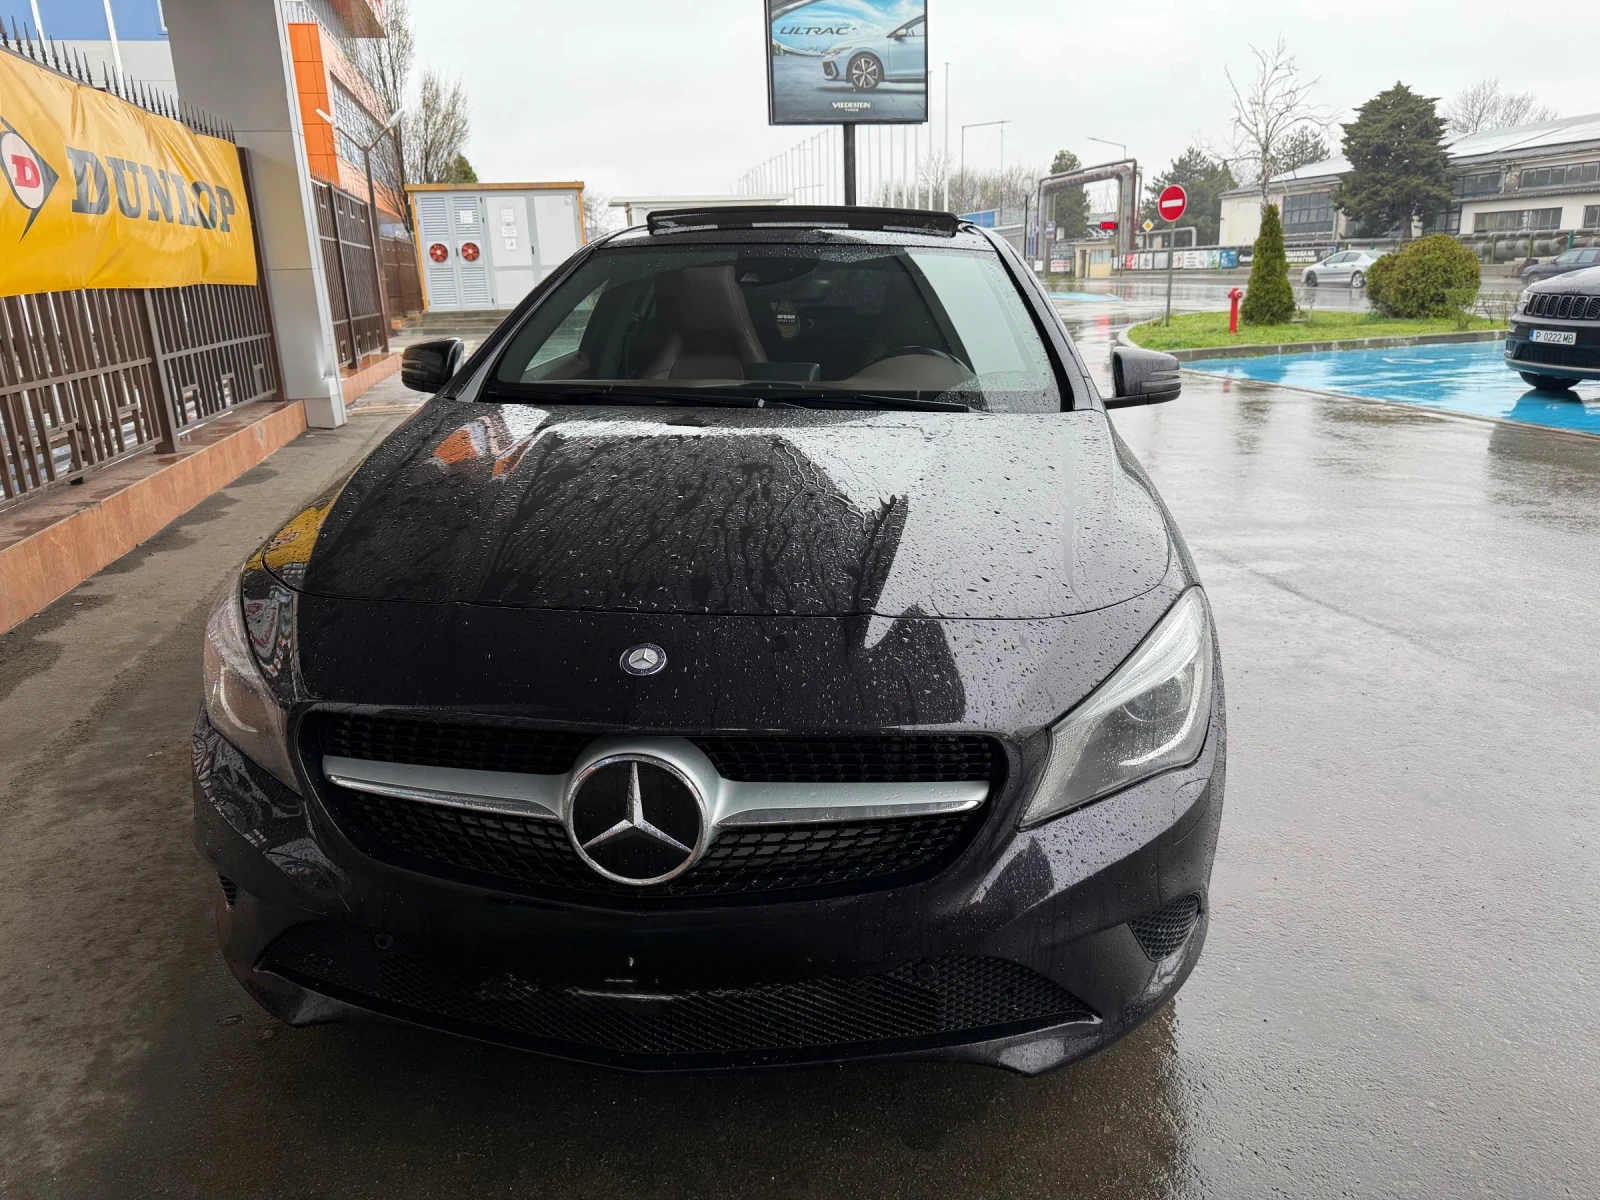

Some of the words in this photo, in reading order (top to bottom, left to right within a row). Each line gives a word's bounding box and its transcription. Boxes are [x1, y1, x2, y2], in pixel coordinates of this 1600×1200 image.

[831, 101, 871, 109] VREDESTEIN
[11, 154, 41, 188] D
[66, 146, 235, 232] DUNLOP
[1536, 331, 1541, 340] P
[1544, 332, 1562, 342] 0222
